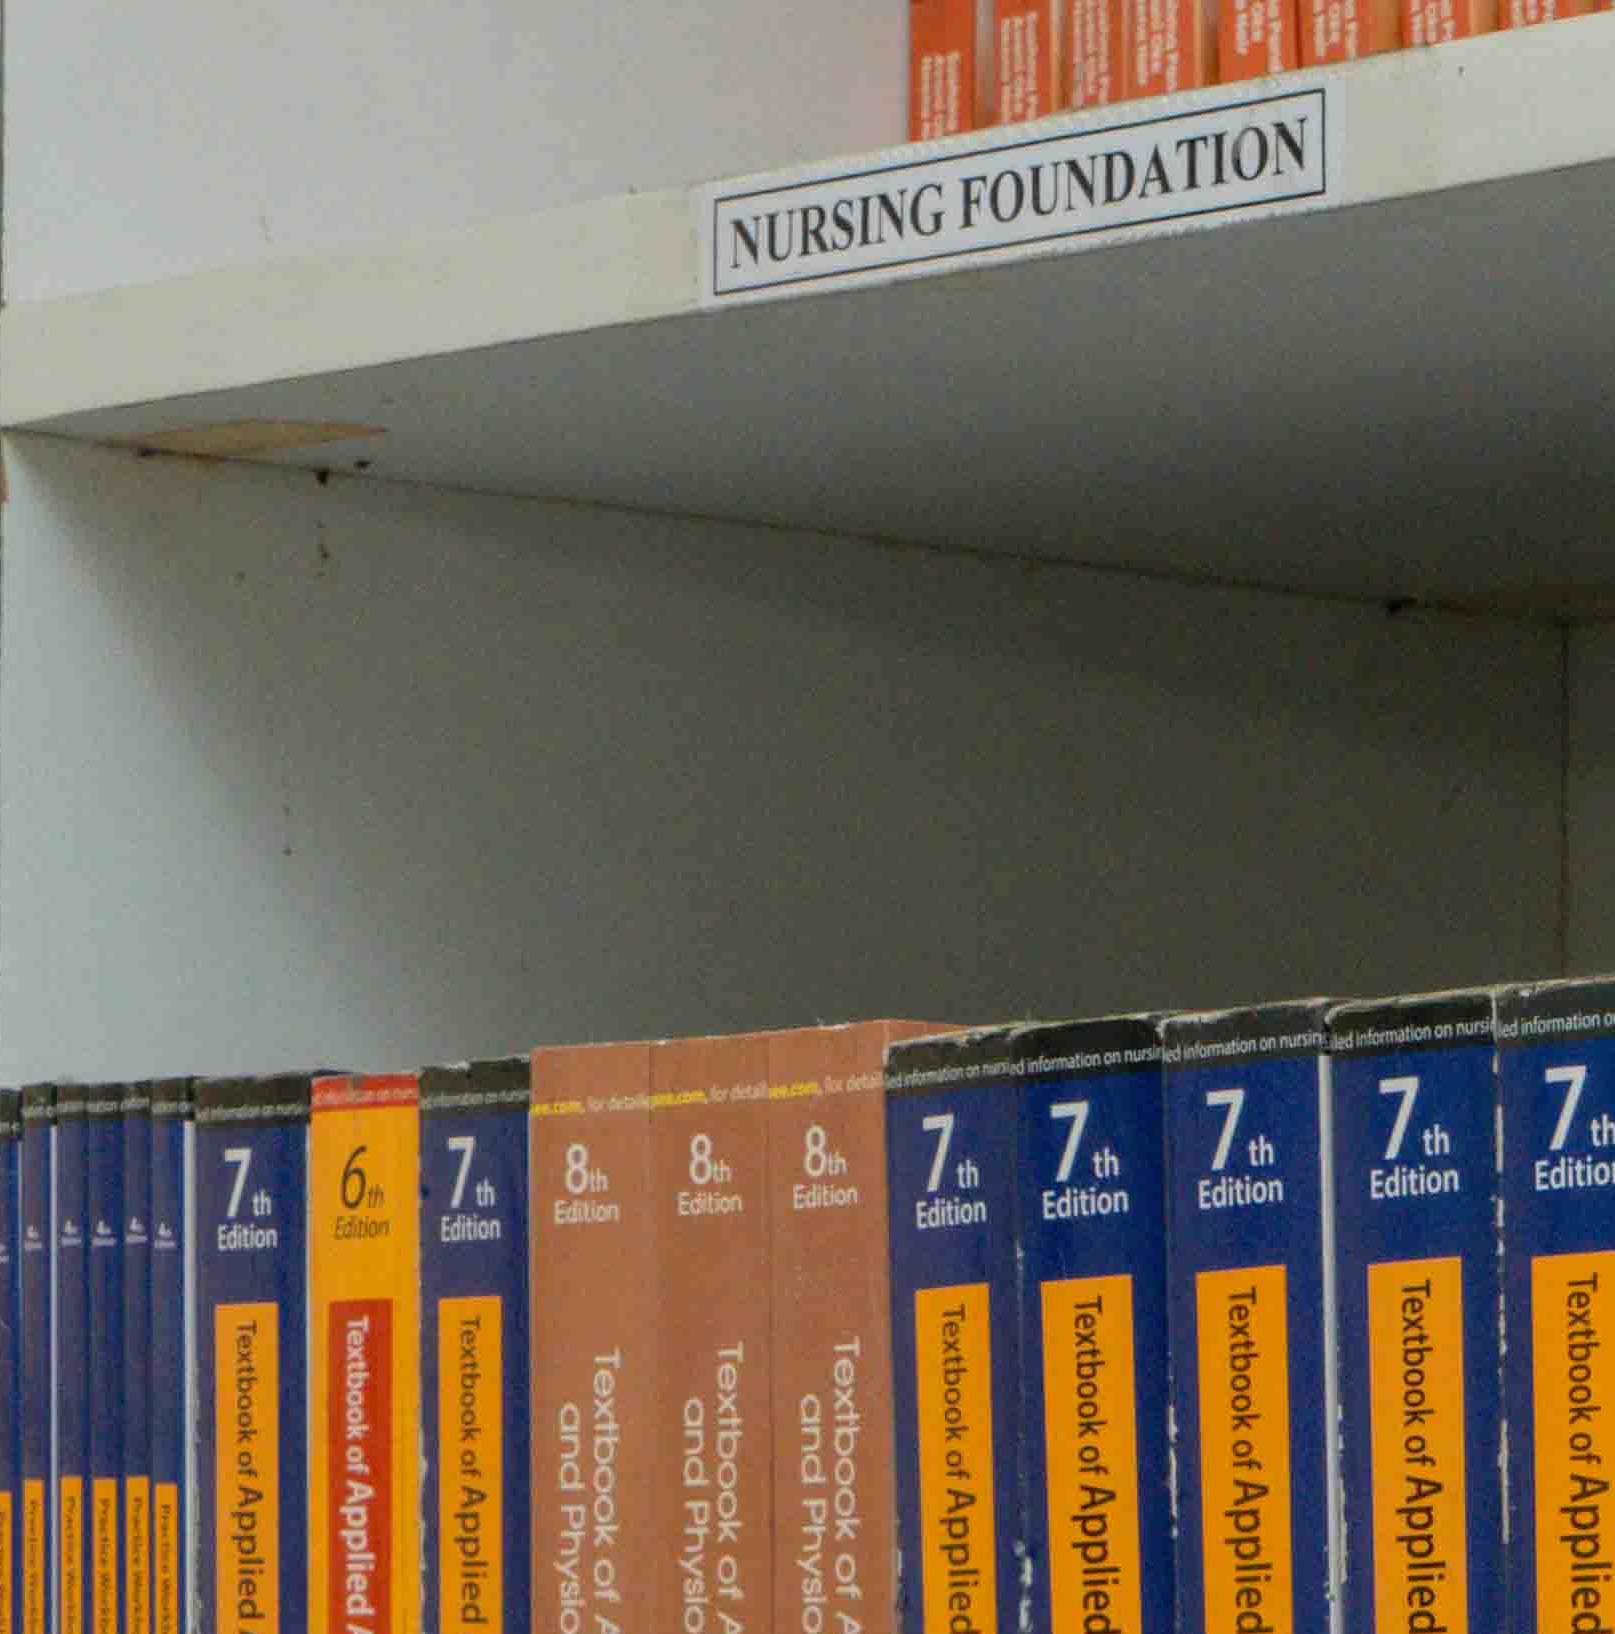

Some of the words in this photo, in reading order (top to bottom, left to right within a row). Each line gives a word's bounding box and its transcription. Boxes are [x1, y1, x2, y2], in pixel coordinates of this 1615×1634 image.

[730, 178, 944, 272] NURSING
[958, 114, 1309, 231] FOUNDATION
[334, 1216, 391, 1241] Edition
[677, 1190, 743, 1216] Edition
[346, 1317, 370, 1438] Textbook
[346, 1447, 369, 1472] of
[684, 1398, 710, 1488] and
[716, 1341, 744, 1543] Textbook
[340, 1481, 375, 1616] Applied
[717, 1555, 744, 1599] of
